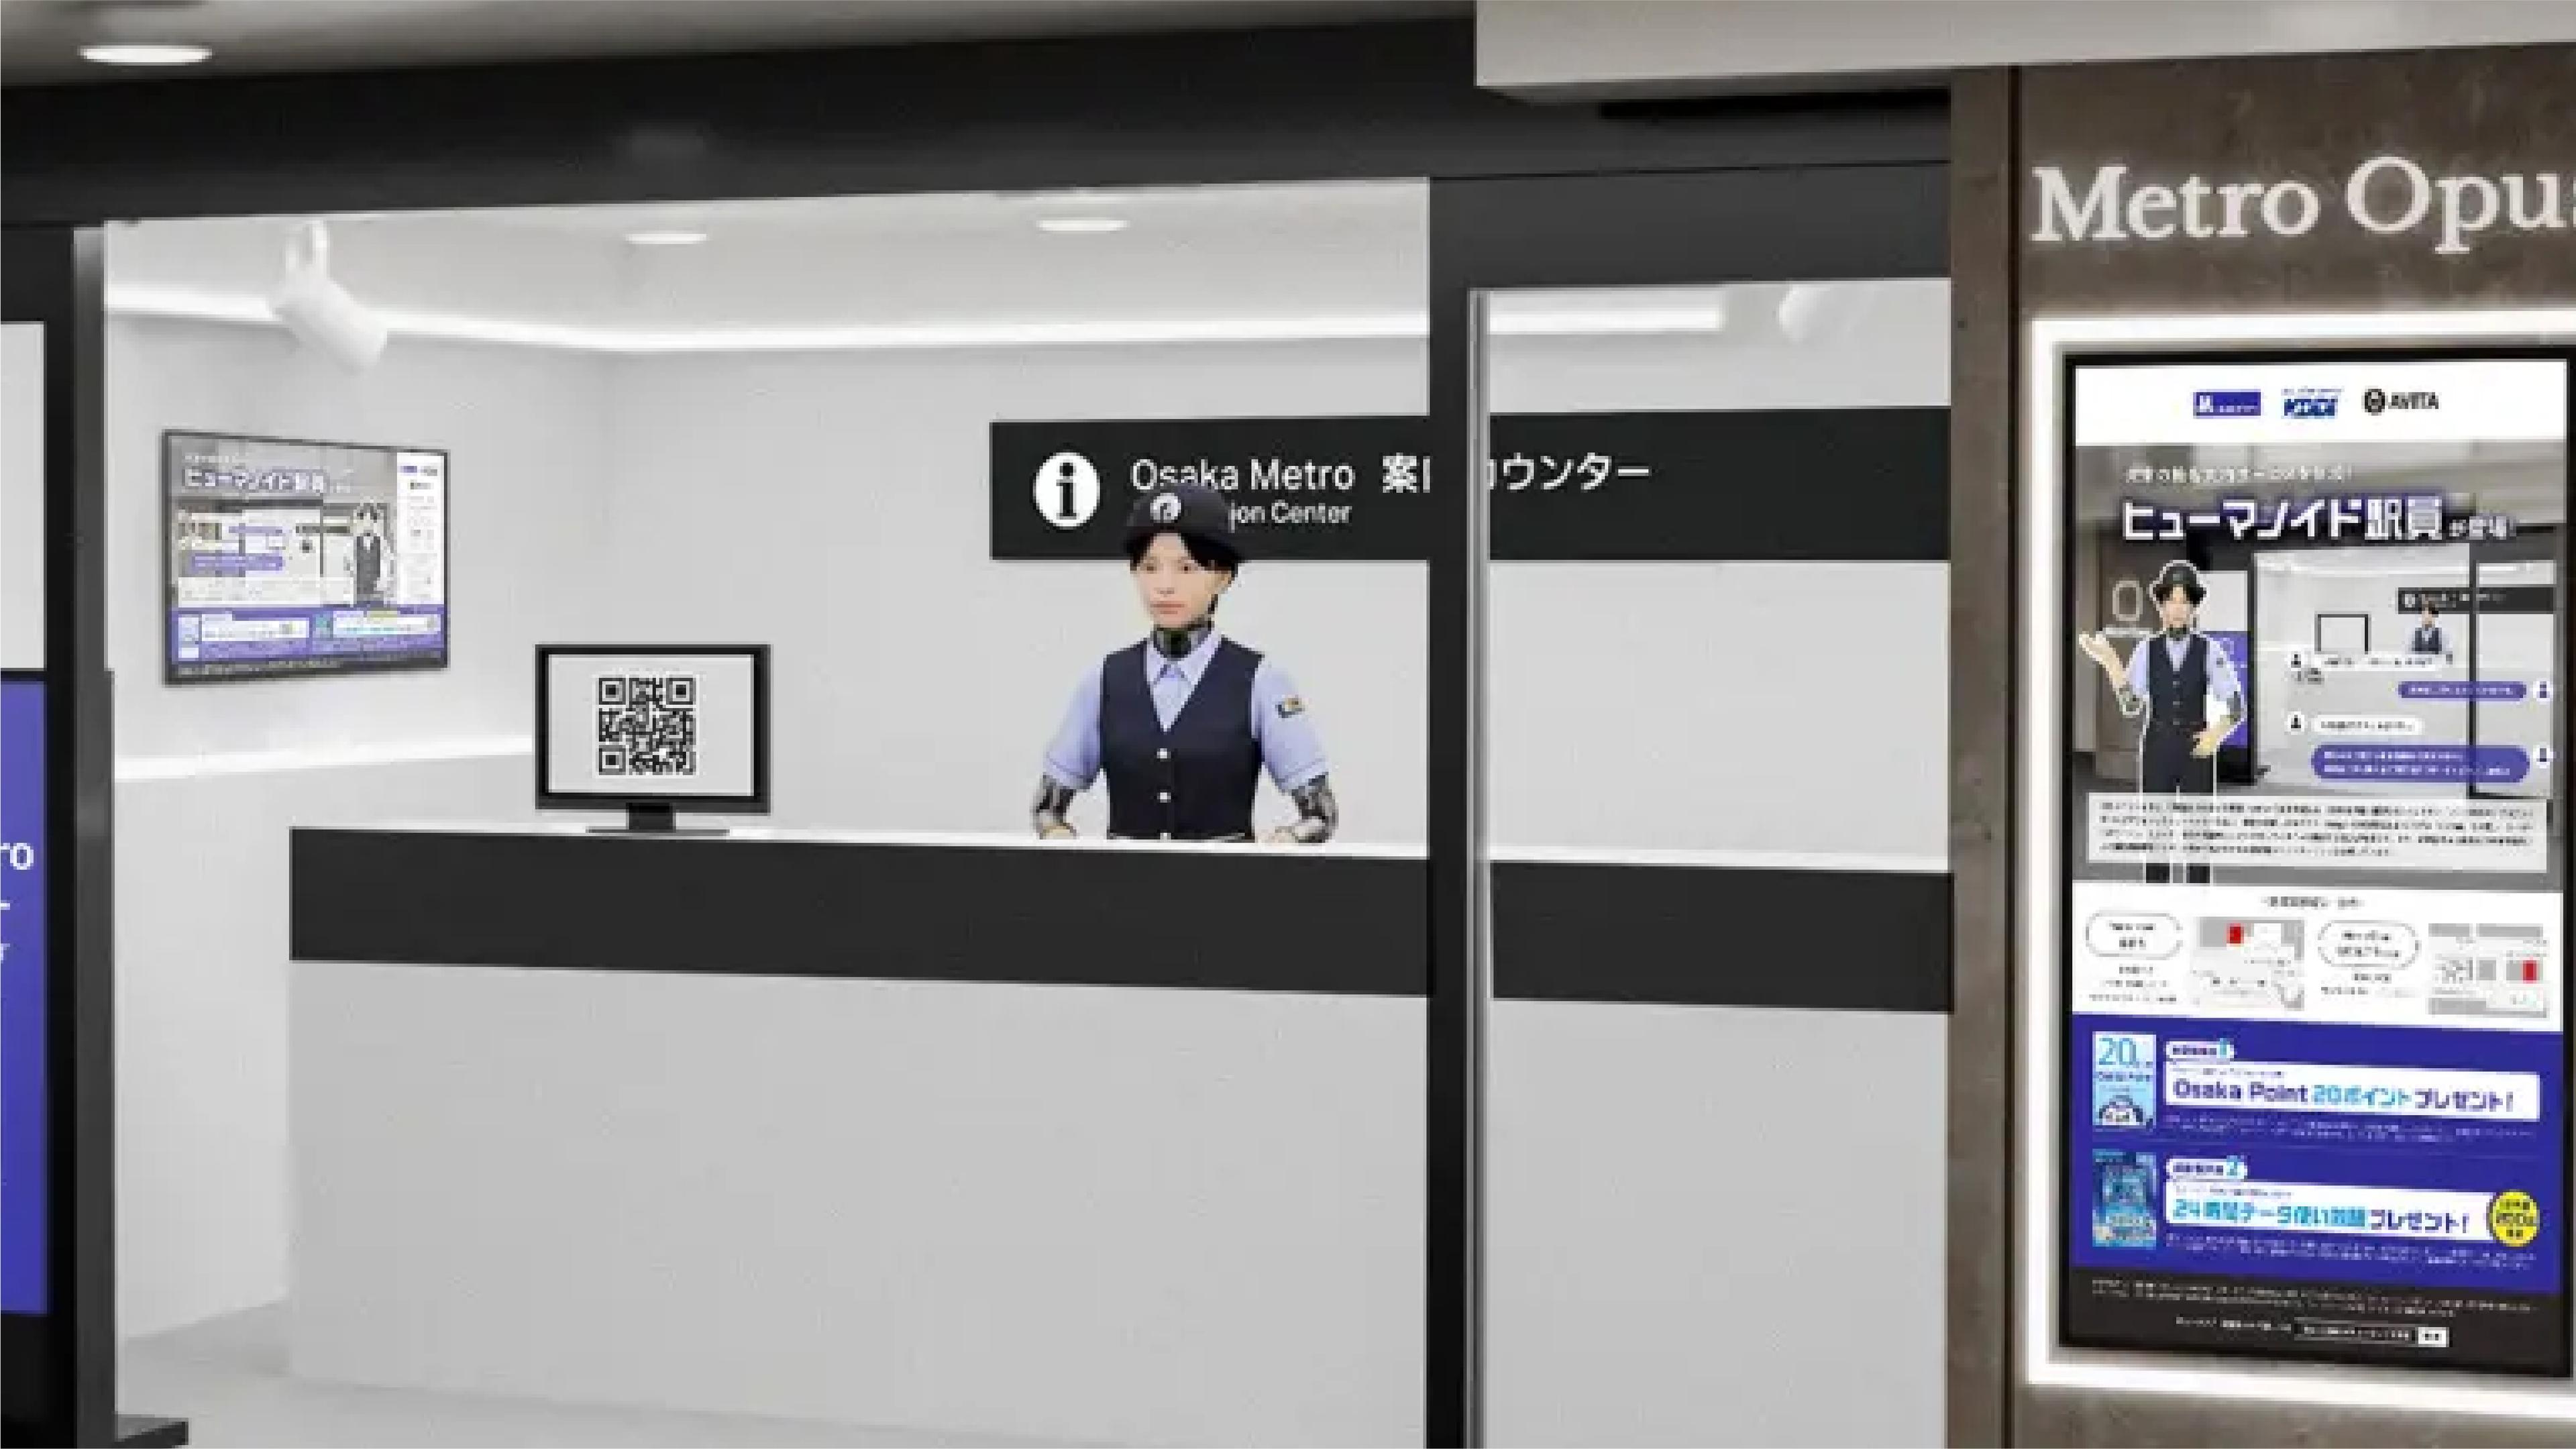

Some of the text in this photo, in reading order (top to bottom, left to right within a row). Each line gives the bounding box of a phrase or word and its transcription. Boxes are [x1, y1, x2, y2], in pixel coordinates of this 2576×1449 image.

[2030, 155, 2576, 255] Metro Opu
[1131, 458, 1239, 491] Osaka
[1250, 458, 1356, 491] Metro
[1271, 501, 1352, 525] Center
[2172, 1077, 2243, 1101] Osaka
[2249, 1081, 2309, 1104] Point
